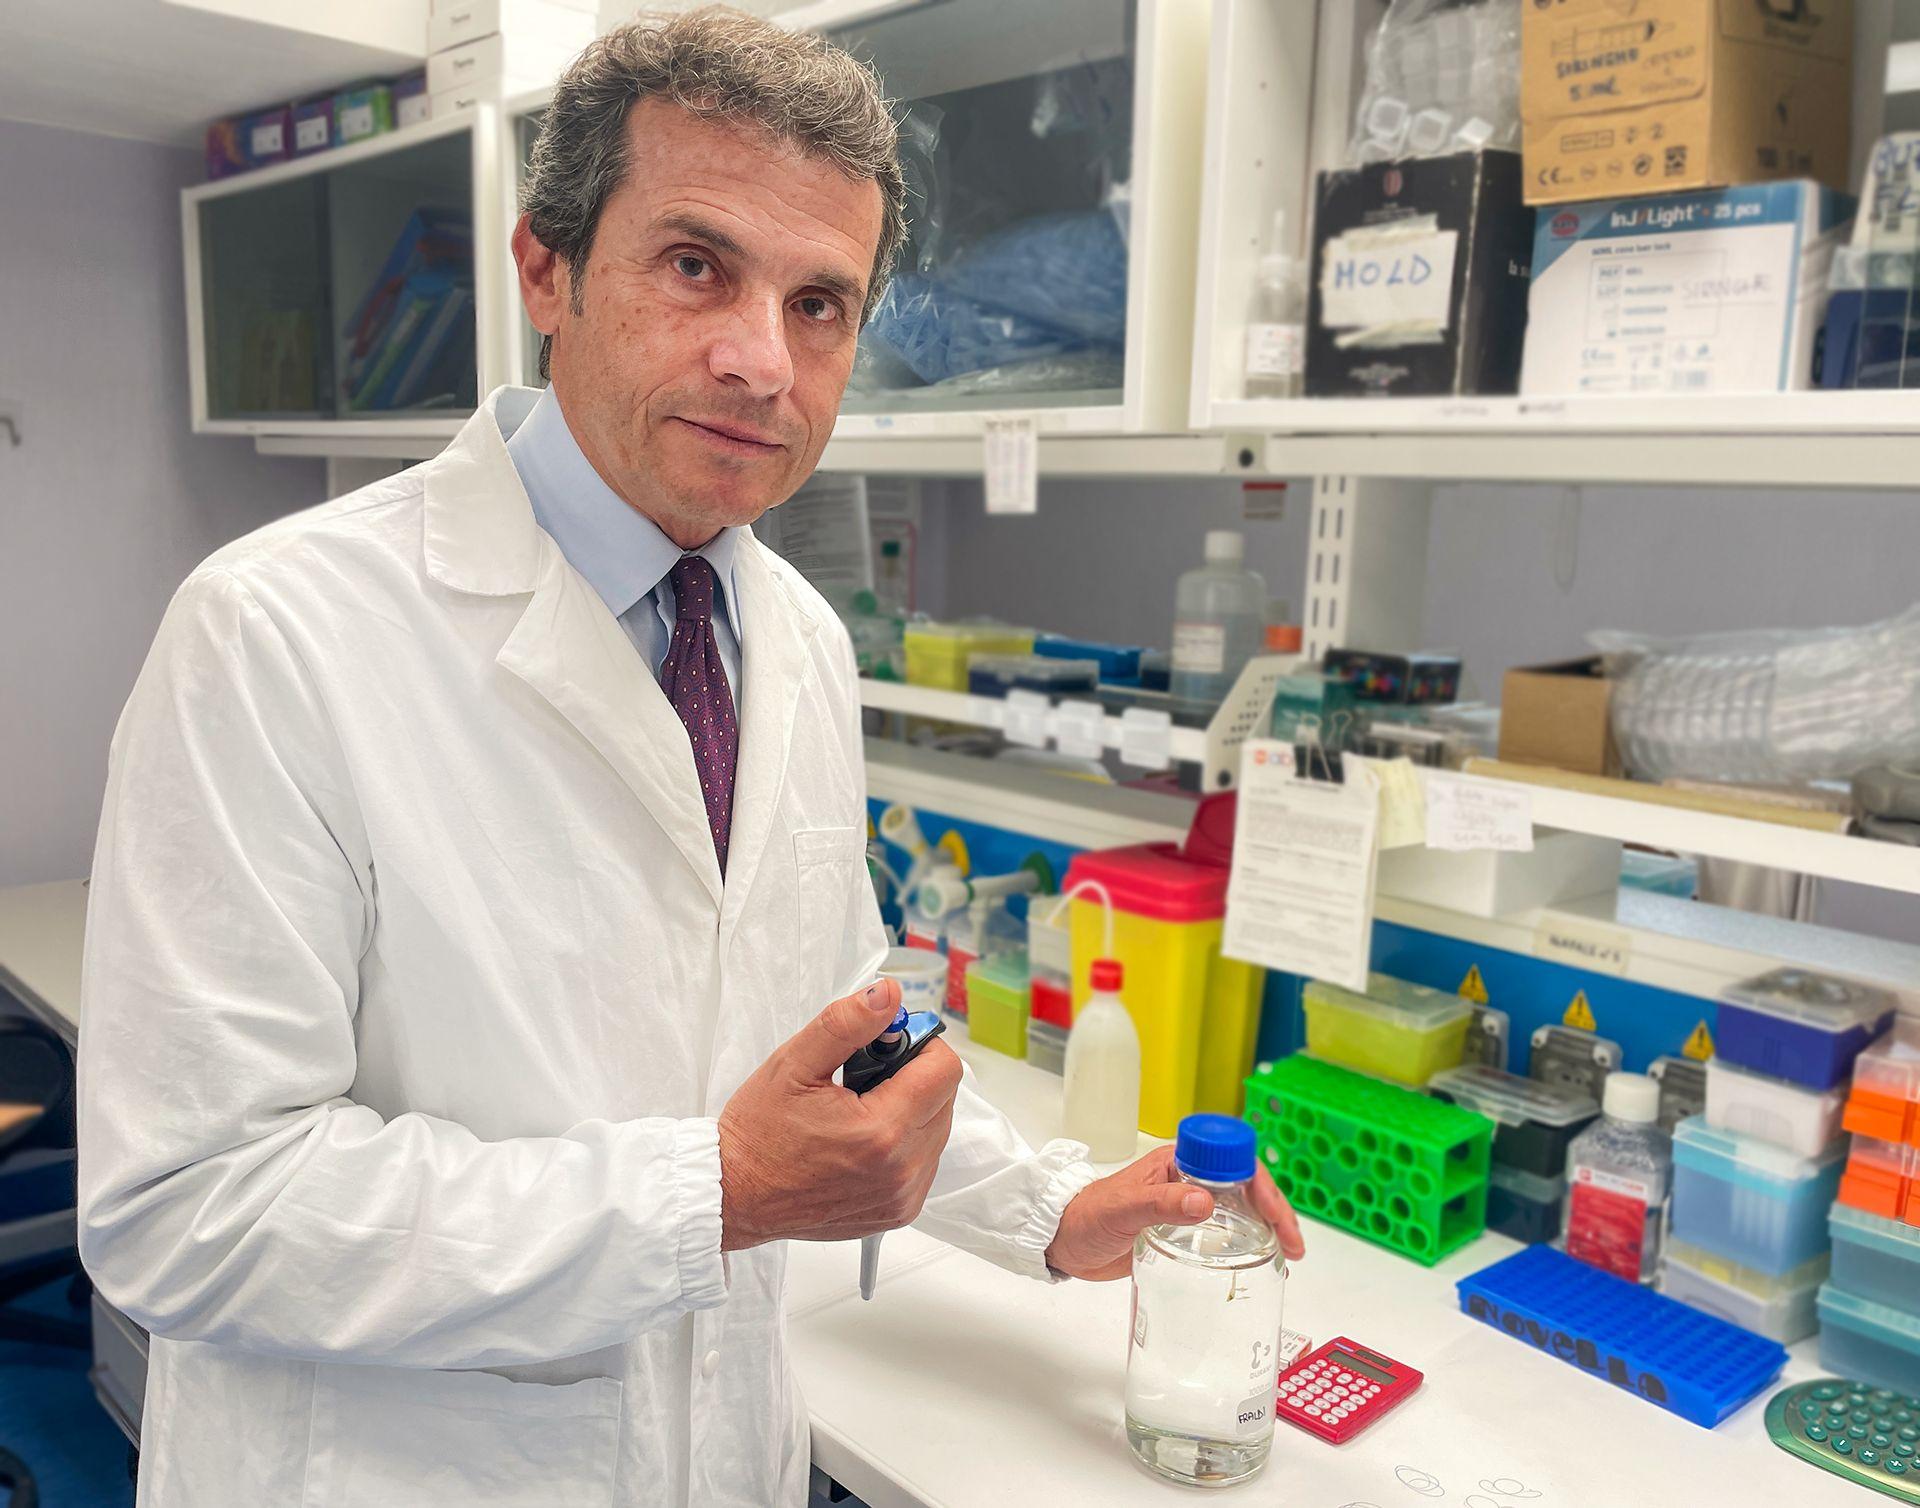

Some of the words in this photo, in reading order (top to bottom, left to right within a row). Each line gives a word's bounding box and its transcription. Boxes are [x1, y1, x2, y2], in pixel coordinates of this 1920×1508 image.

[1714, 203, 1733, 219] 25
[1735, 203, 1761, 219] pcs
[1334, 254, 1432, 289] MOLD
